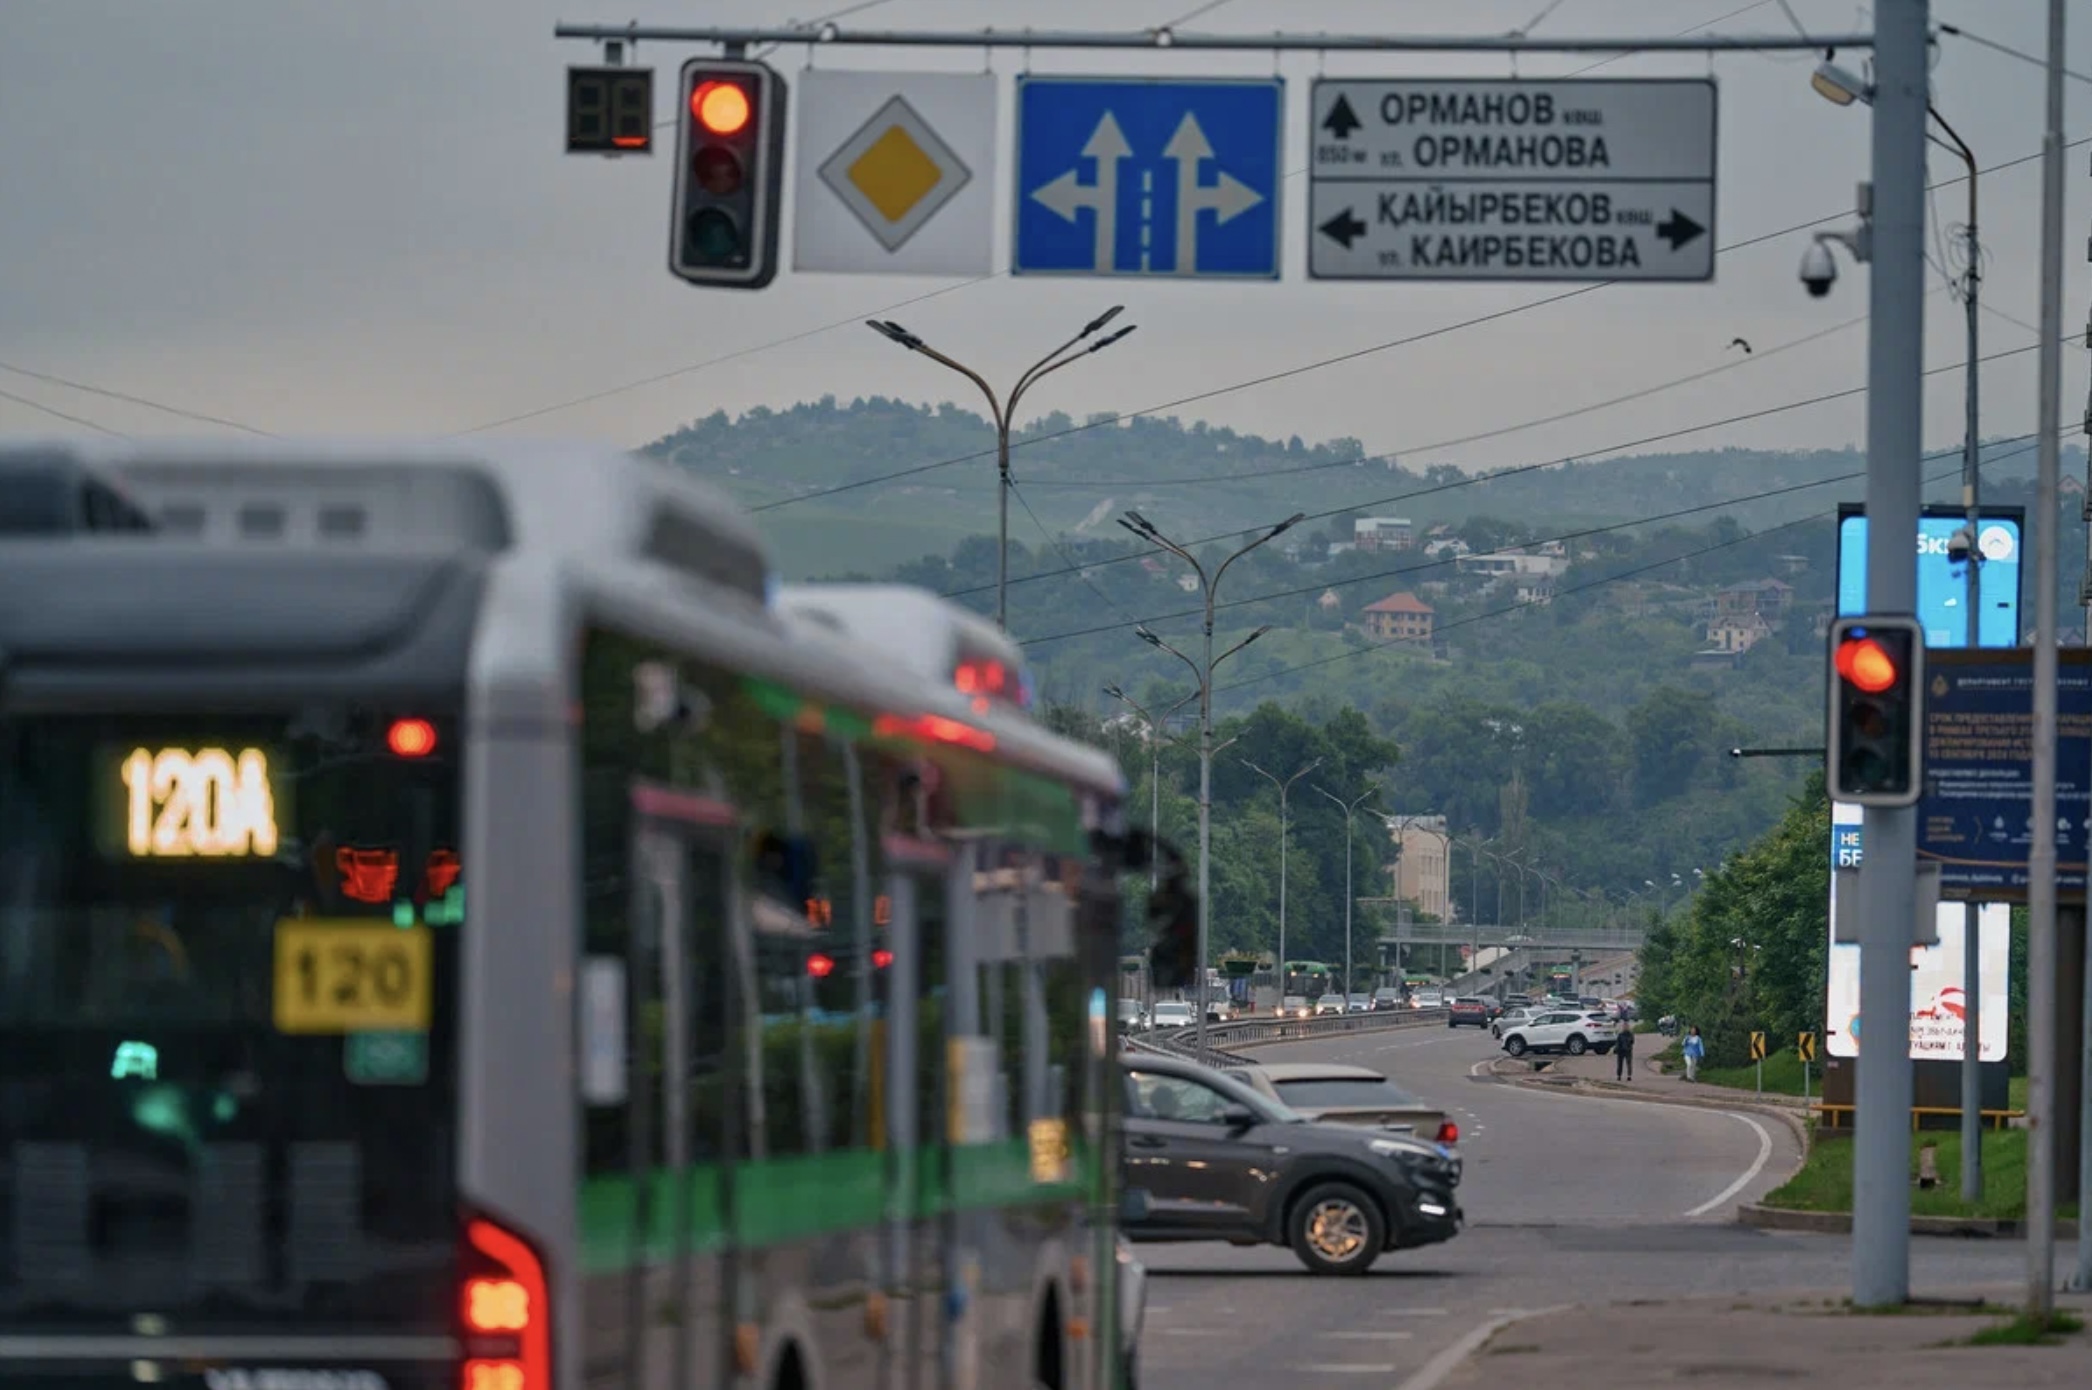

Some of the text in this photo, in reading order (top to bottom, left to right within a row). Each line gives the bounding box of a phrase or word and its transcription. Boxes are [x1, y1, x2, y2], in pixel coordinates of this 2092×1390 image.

[1380, 93, 1554, 125] ОРМАНОВ
[1413, 136, 1610, 168] ОРМАНОВА
[1377, 186, 1611, 228] ҚАЙЫРБЕКОВ
[1410, 234, 1642, 269] КАИРБЕКОВА
[294, 944, 413, 1009] 120
